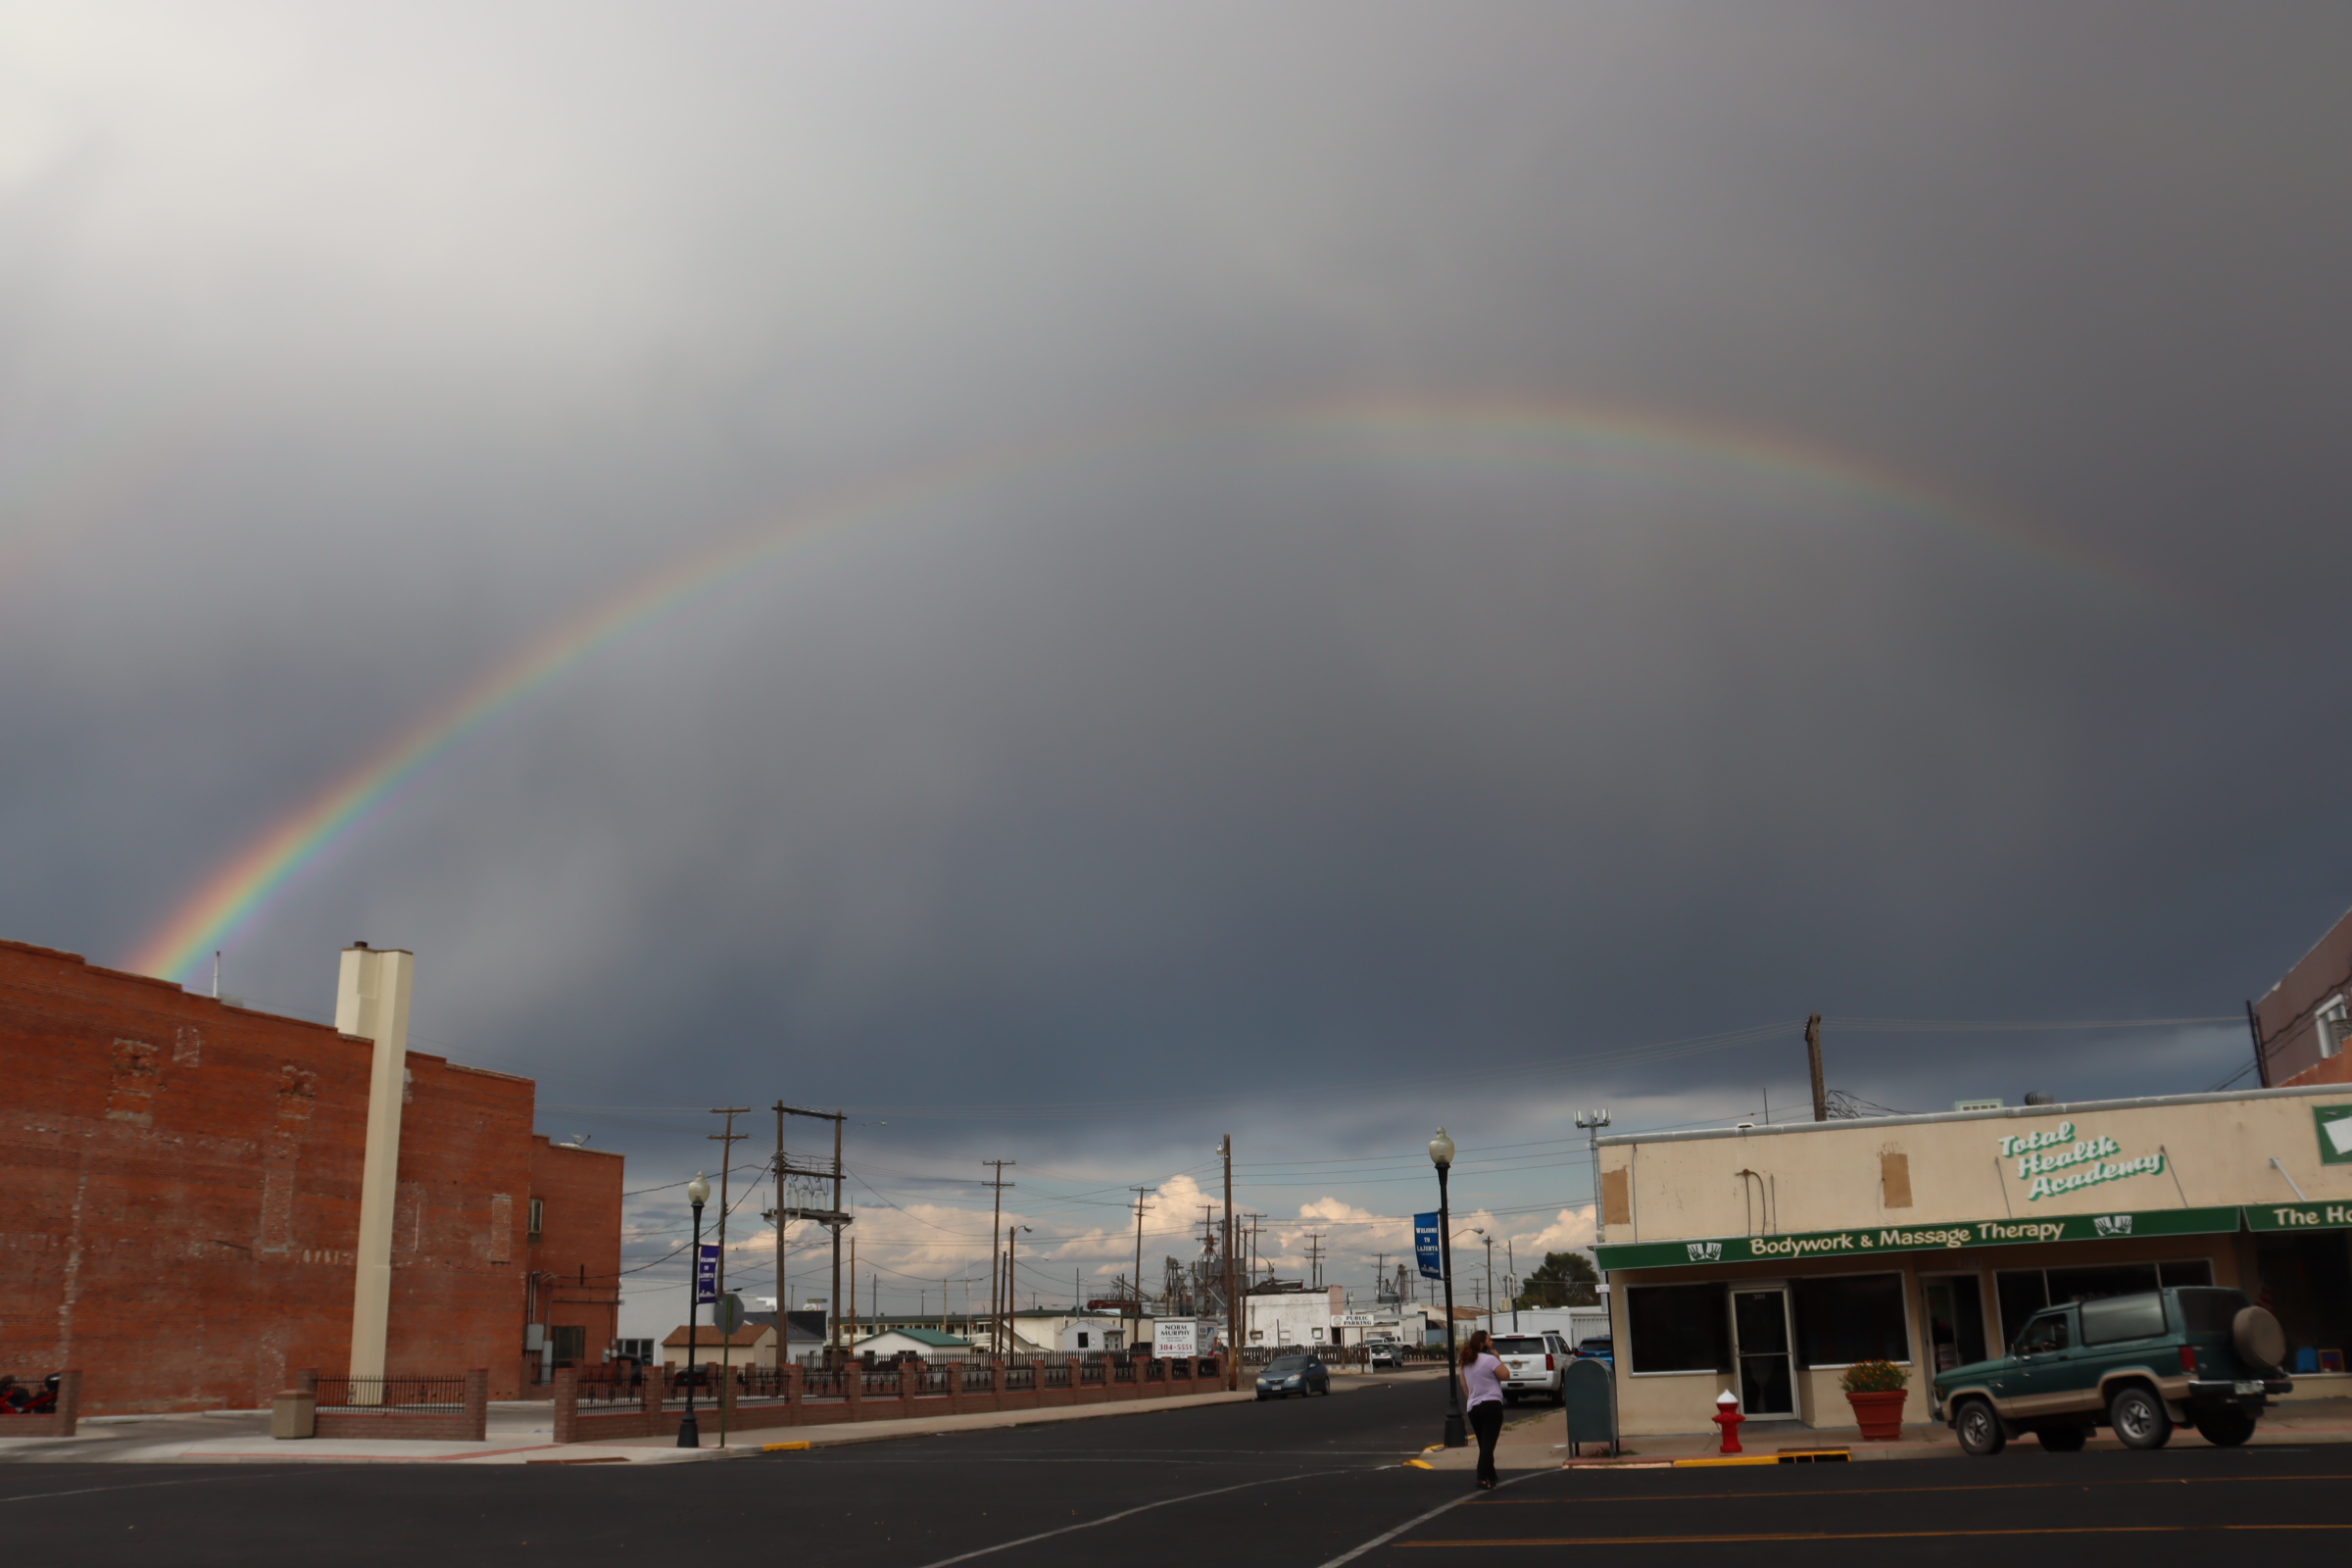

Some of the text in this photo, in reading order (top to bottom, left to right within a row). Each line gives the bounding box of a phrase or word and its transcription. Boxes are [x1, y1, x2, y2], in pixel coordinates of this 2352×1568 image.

[1998, 1121, 2076, 1158] Total
[2018, 1136, 2121, 1180] Health
[2028, 1153, 2164, 1200] Academy
[2273, 1207, 2321, 1225] The
[1749, 1222, 2066, 1257] Bodywork & Massage Therapy
